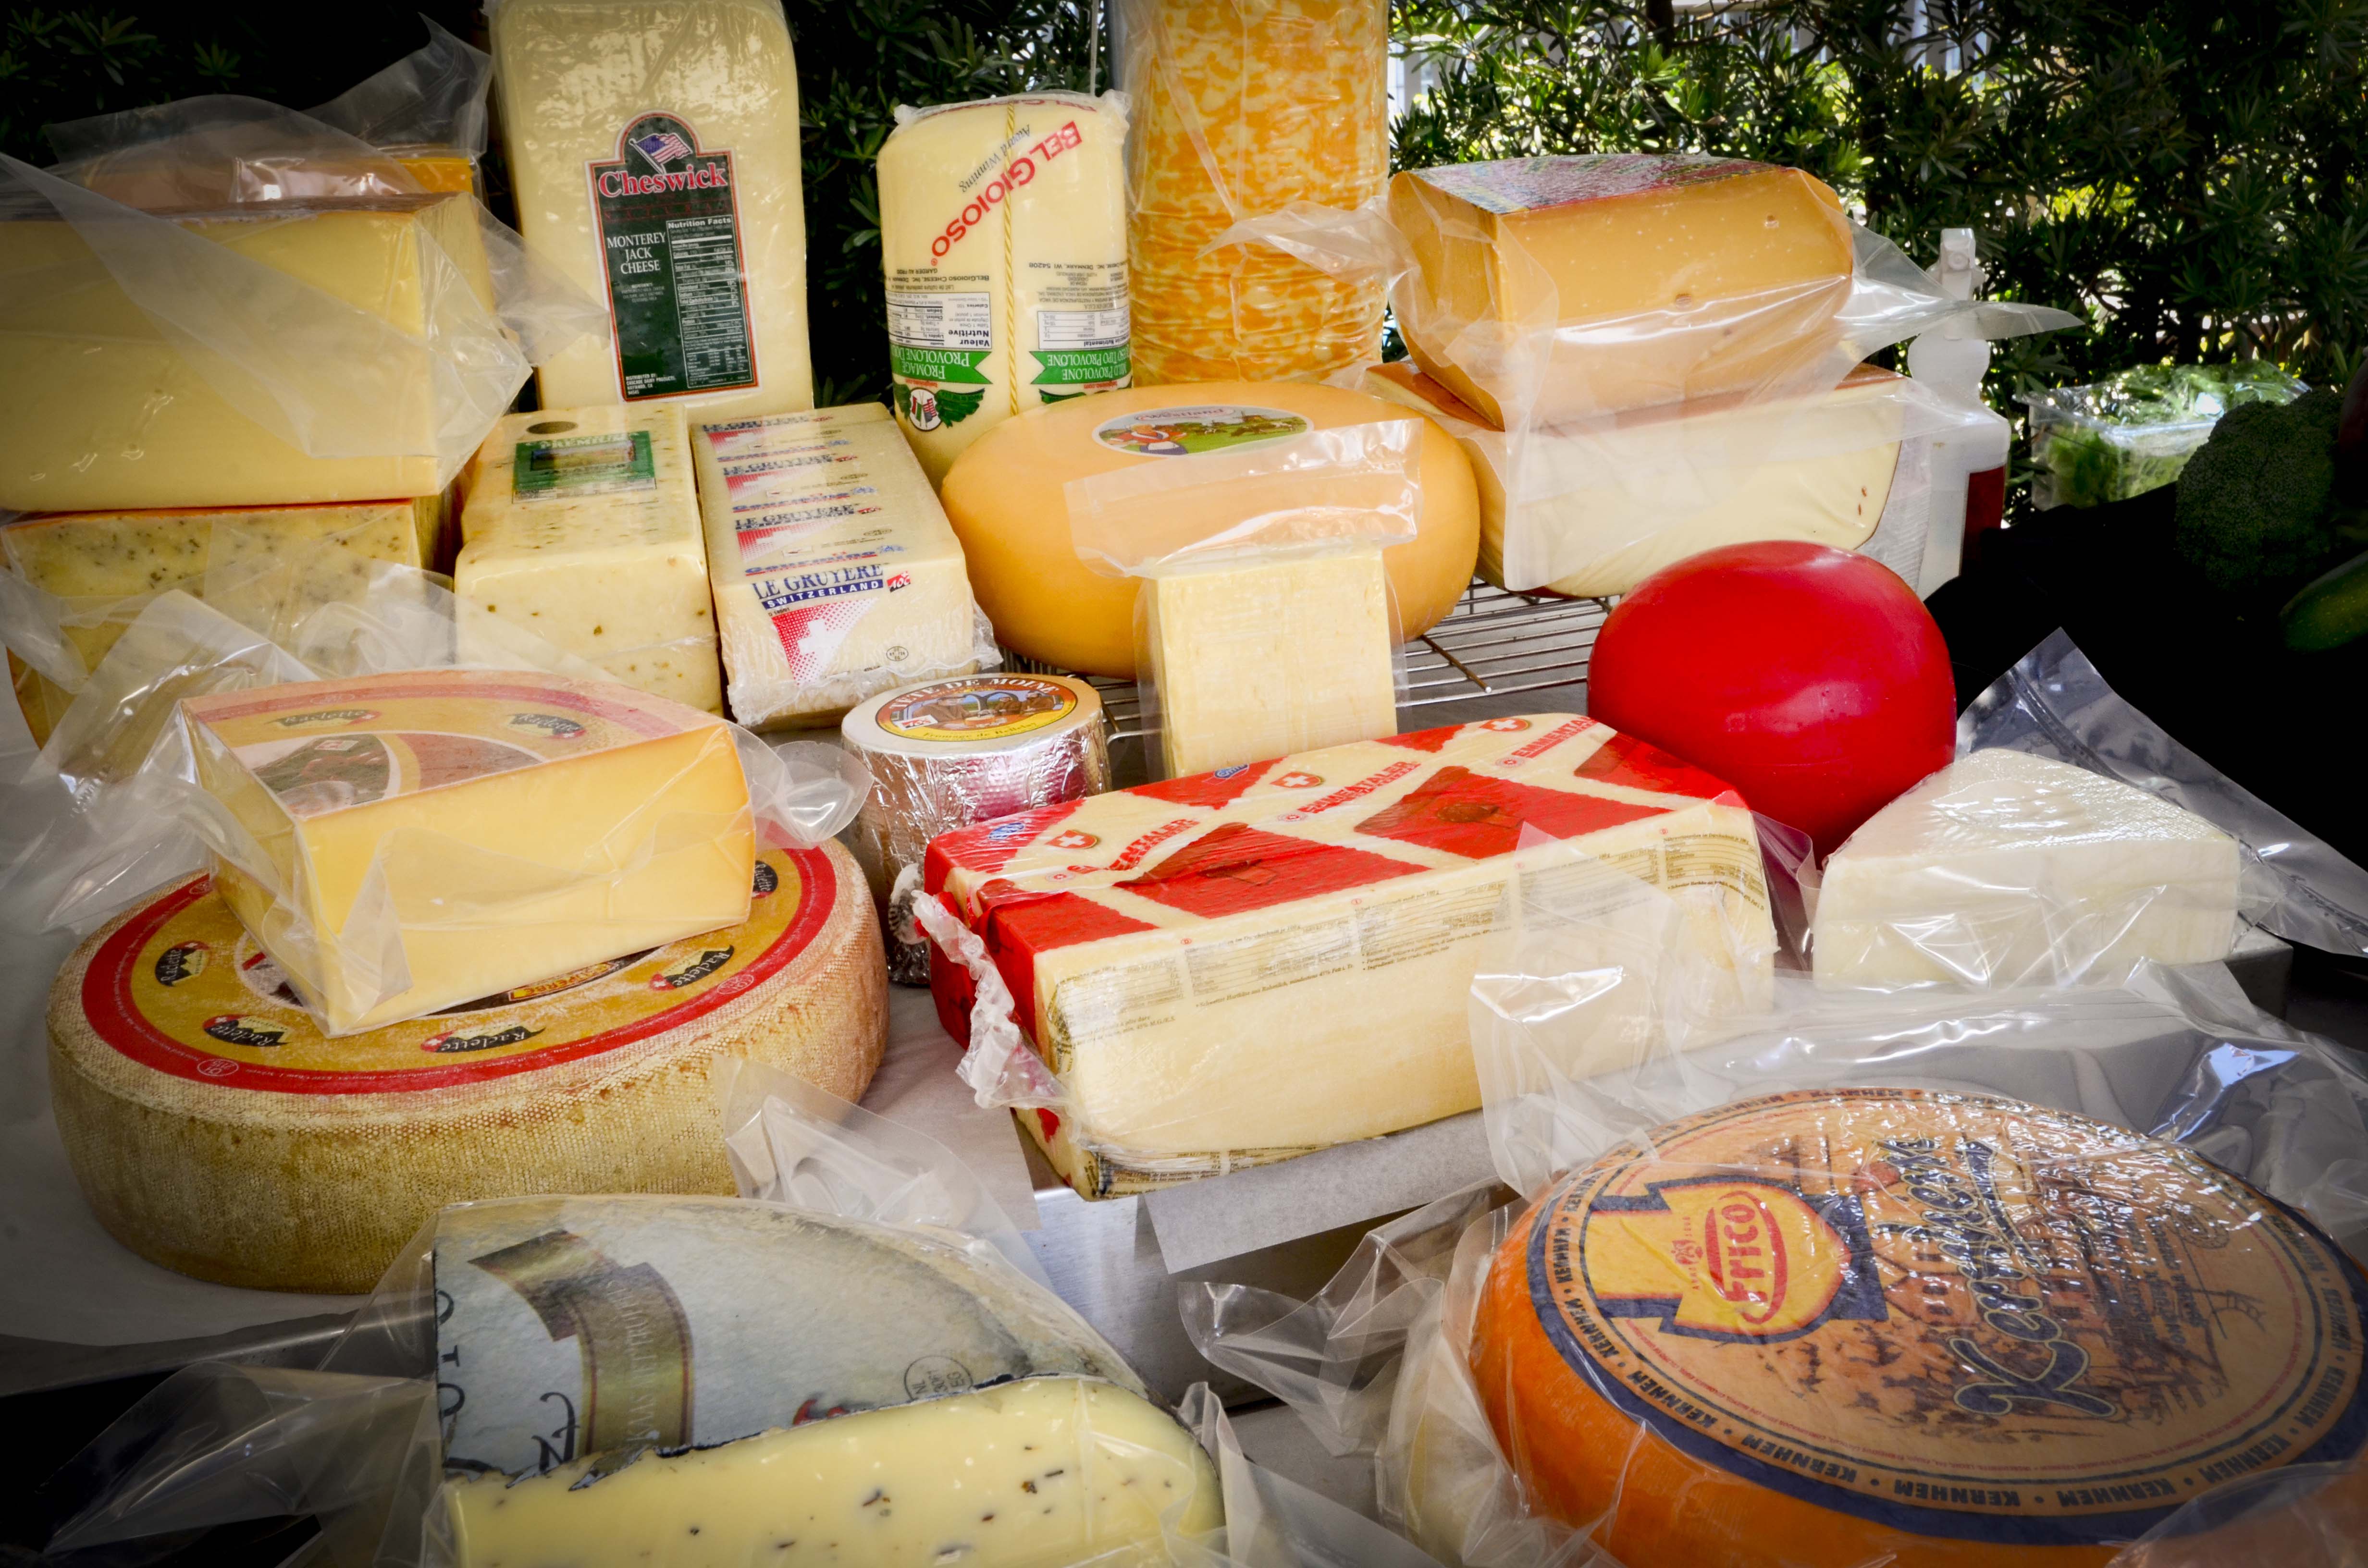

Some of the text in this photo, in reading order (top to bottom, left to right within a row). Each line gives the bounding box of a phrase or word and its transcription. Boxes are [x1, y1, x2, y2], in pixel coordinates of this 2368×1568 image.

[958, 124, 1031, 193] Award Winning
[598, 162, 728, 197] Cheswick
[932, 121, 1082, 257] BELGIOIOSO
[667, 220, 705, 229] Nutrition
[607, 232, 666, 248] MONTEREY
[625, 247, 652, 263] JACK
[620, 260, 661, 274] CHEESE
[905, 348, 970, 367] PROVOLONE
[1047, 353, 1101, 367] PROVOLONE
[902, 360, 946, 380] FROMAGE
[1061, 366, 1113, 380] PROVOLONE
[752, 579, 781, 600] LE
[889, 575, 911, 589] AOC
[767, 582, 879, 608] SWITZERLAND
[945, 679, 980, 689] DE
[989, 678, 1059, 694] MOINE
[285, 710, 364, 723] Raclette
[160, 948, 183, 982] Raclette
[672, 953, 730, 986] Raclette
[211, 1025, 274, 1046] Raclette
[441, 1031, 525, 1051] Raclette
[1553, 1227, 1573, 1284] KERNHEM
[1565, 1298, 1619, 1359] KERNHEM
[1628, 1369, 1718, 1429] KERNHEM
[2292, 1366, 2347, 1429] KERNHEM
[1742, 1433, 1857, 1484] KERNHEM
[2198, 1432, 2292, 1484] KERNHEM
[1893, 1478, 2021, 1506] KERNHEM
[2058, 1478, 2178, 1508] KERNHEM
